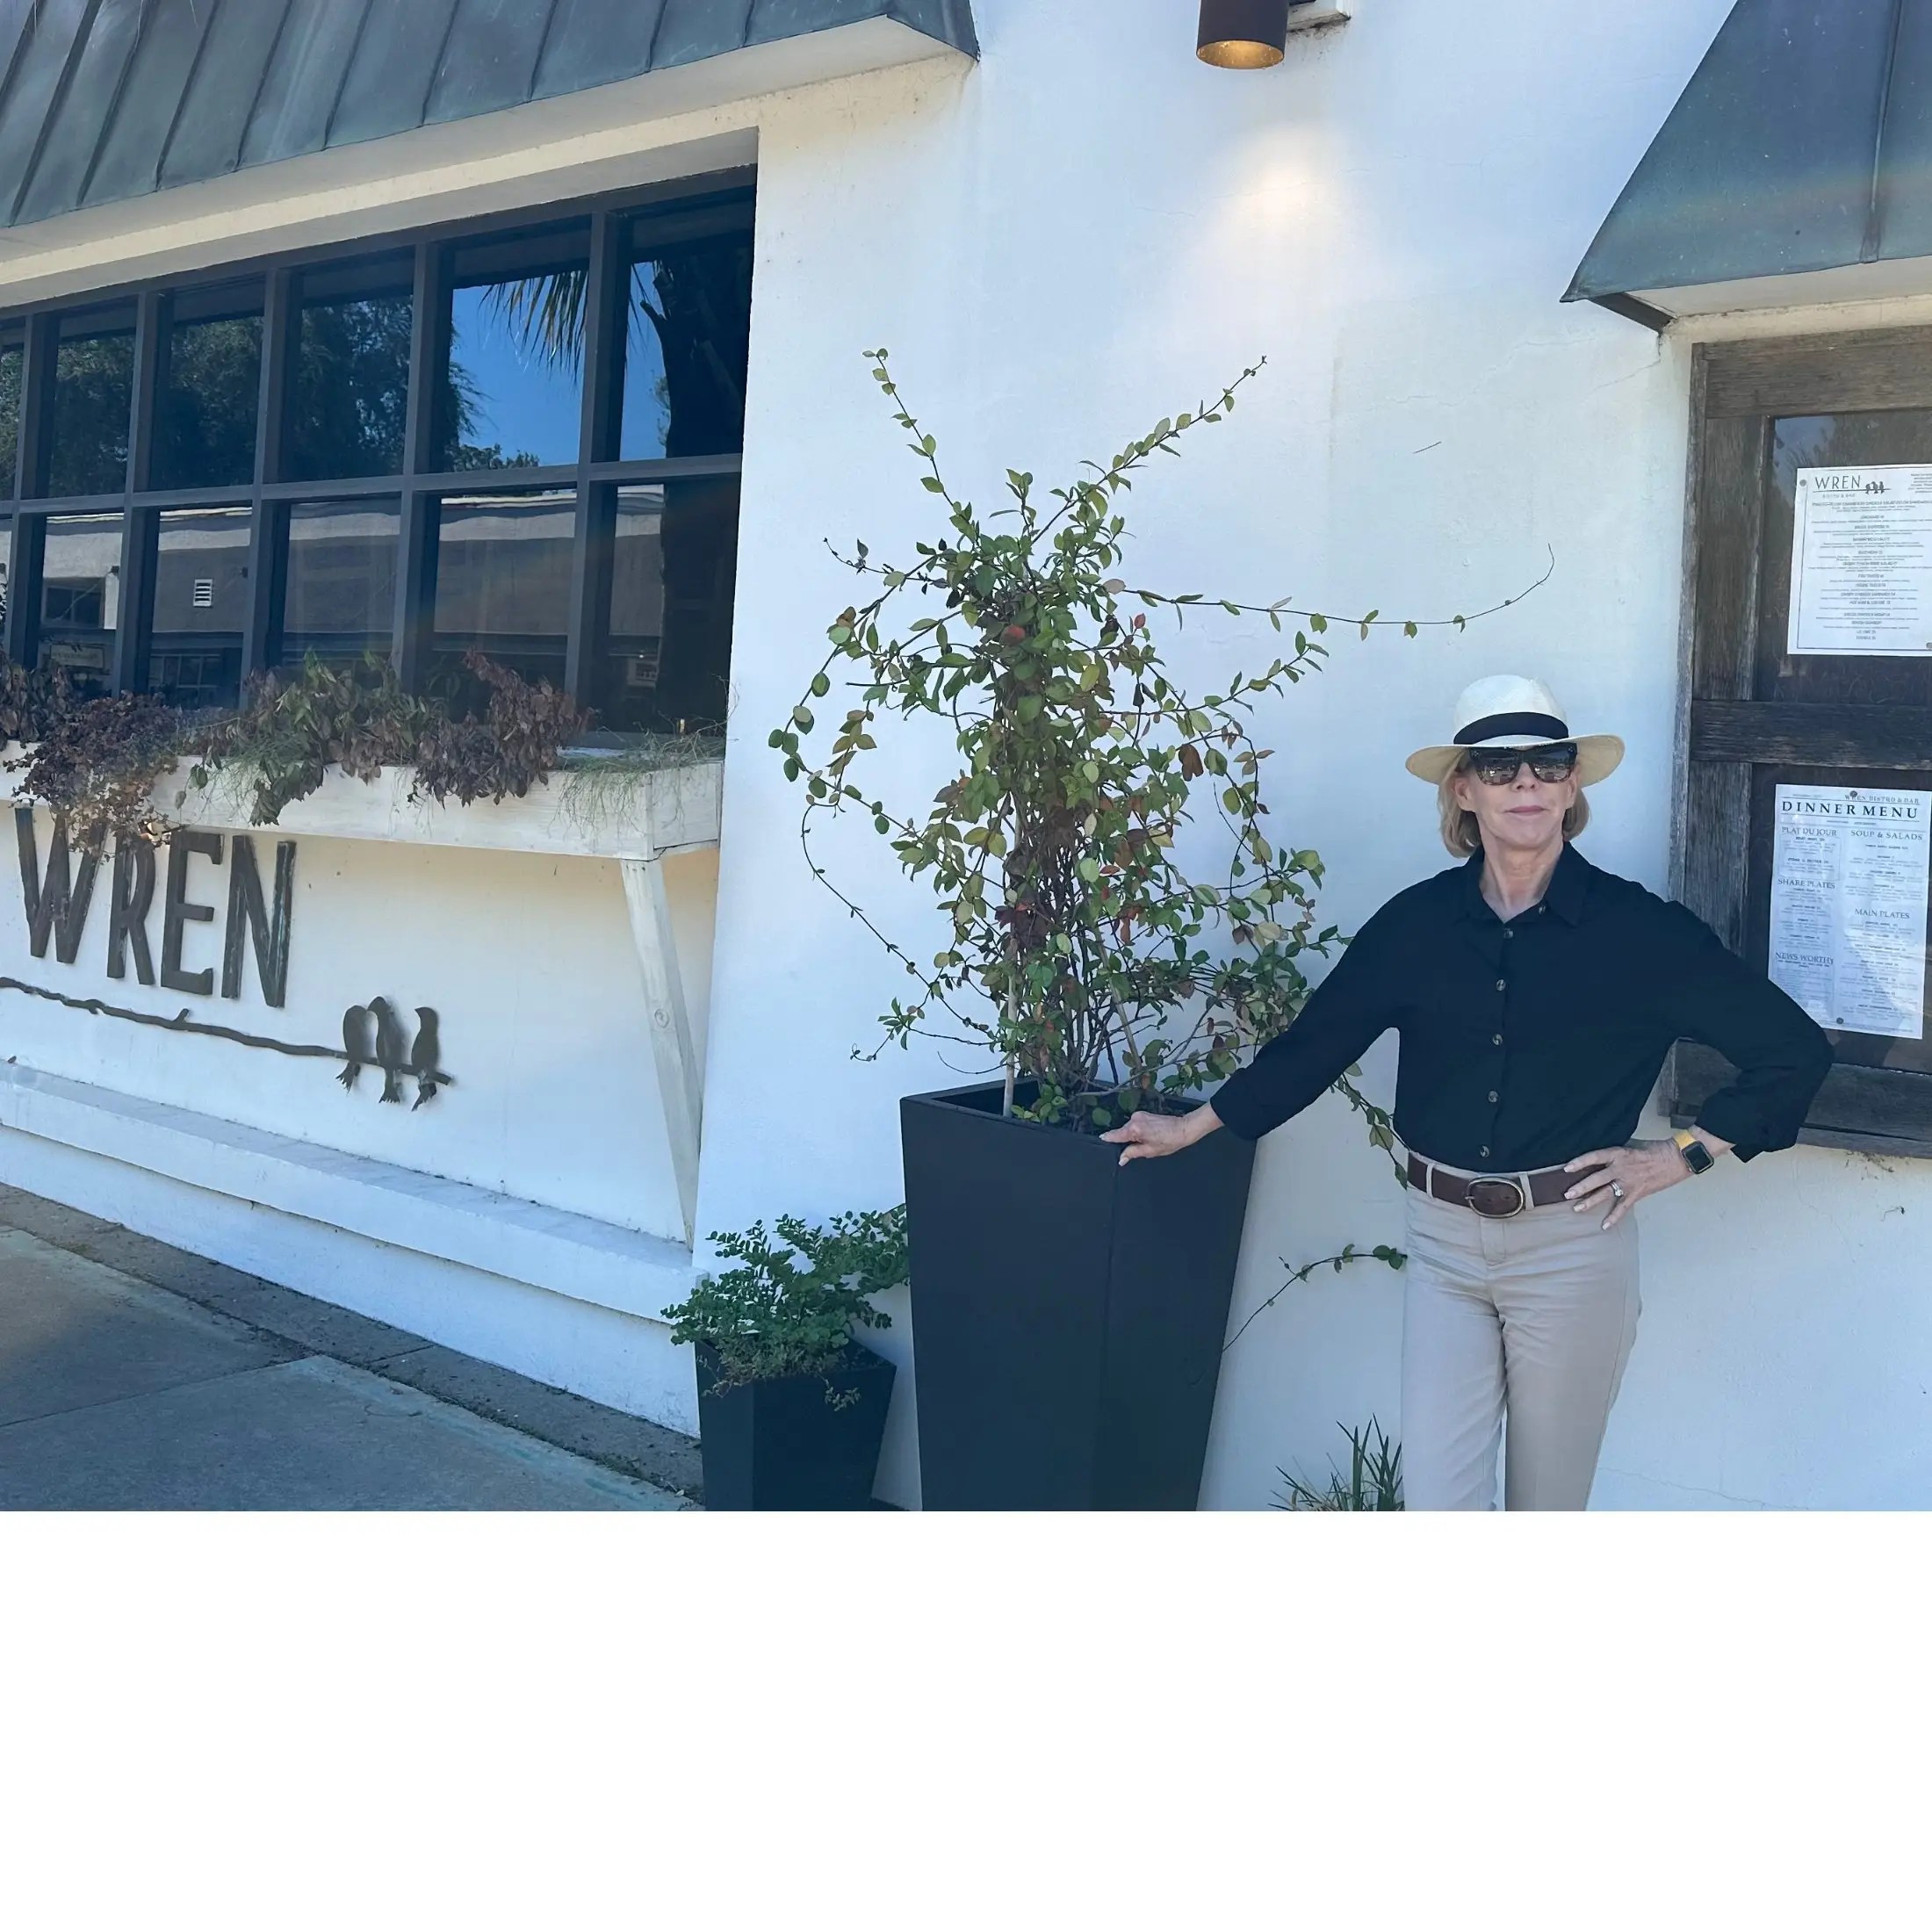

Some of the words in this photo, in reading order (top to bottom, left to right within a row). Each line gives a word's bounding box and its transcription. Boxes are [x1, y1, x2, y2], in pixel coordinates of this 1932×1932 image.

[1815, 475, 1861, 489] WREN
[1782, 801, 1856, 815] DINNER
[1863, 805, 1918, 818] MENU
[1815, 828, 1837, 837] JOUR
[1886, 832, 1923, 840] SALADS
[1807, 880, 1835, 889] PLATES
[15, 807, 297, 1008] WREN
[1855, 908, 1878, 918] MAIN
[1879, 910, 1910, 919] PLATES
[1776, 952, 1799, 961] NEWS
[1800, 954, 1834, 964] WORTHY
